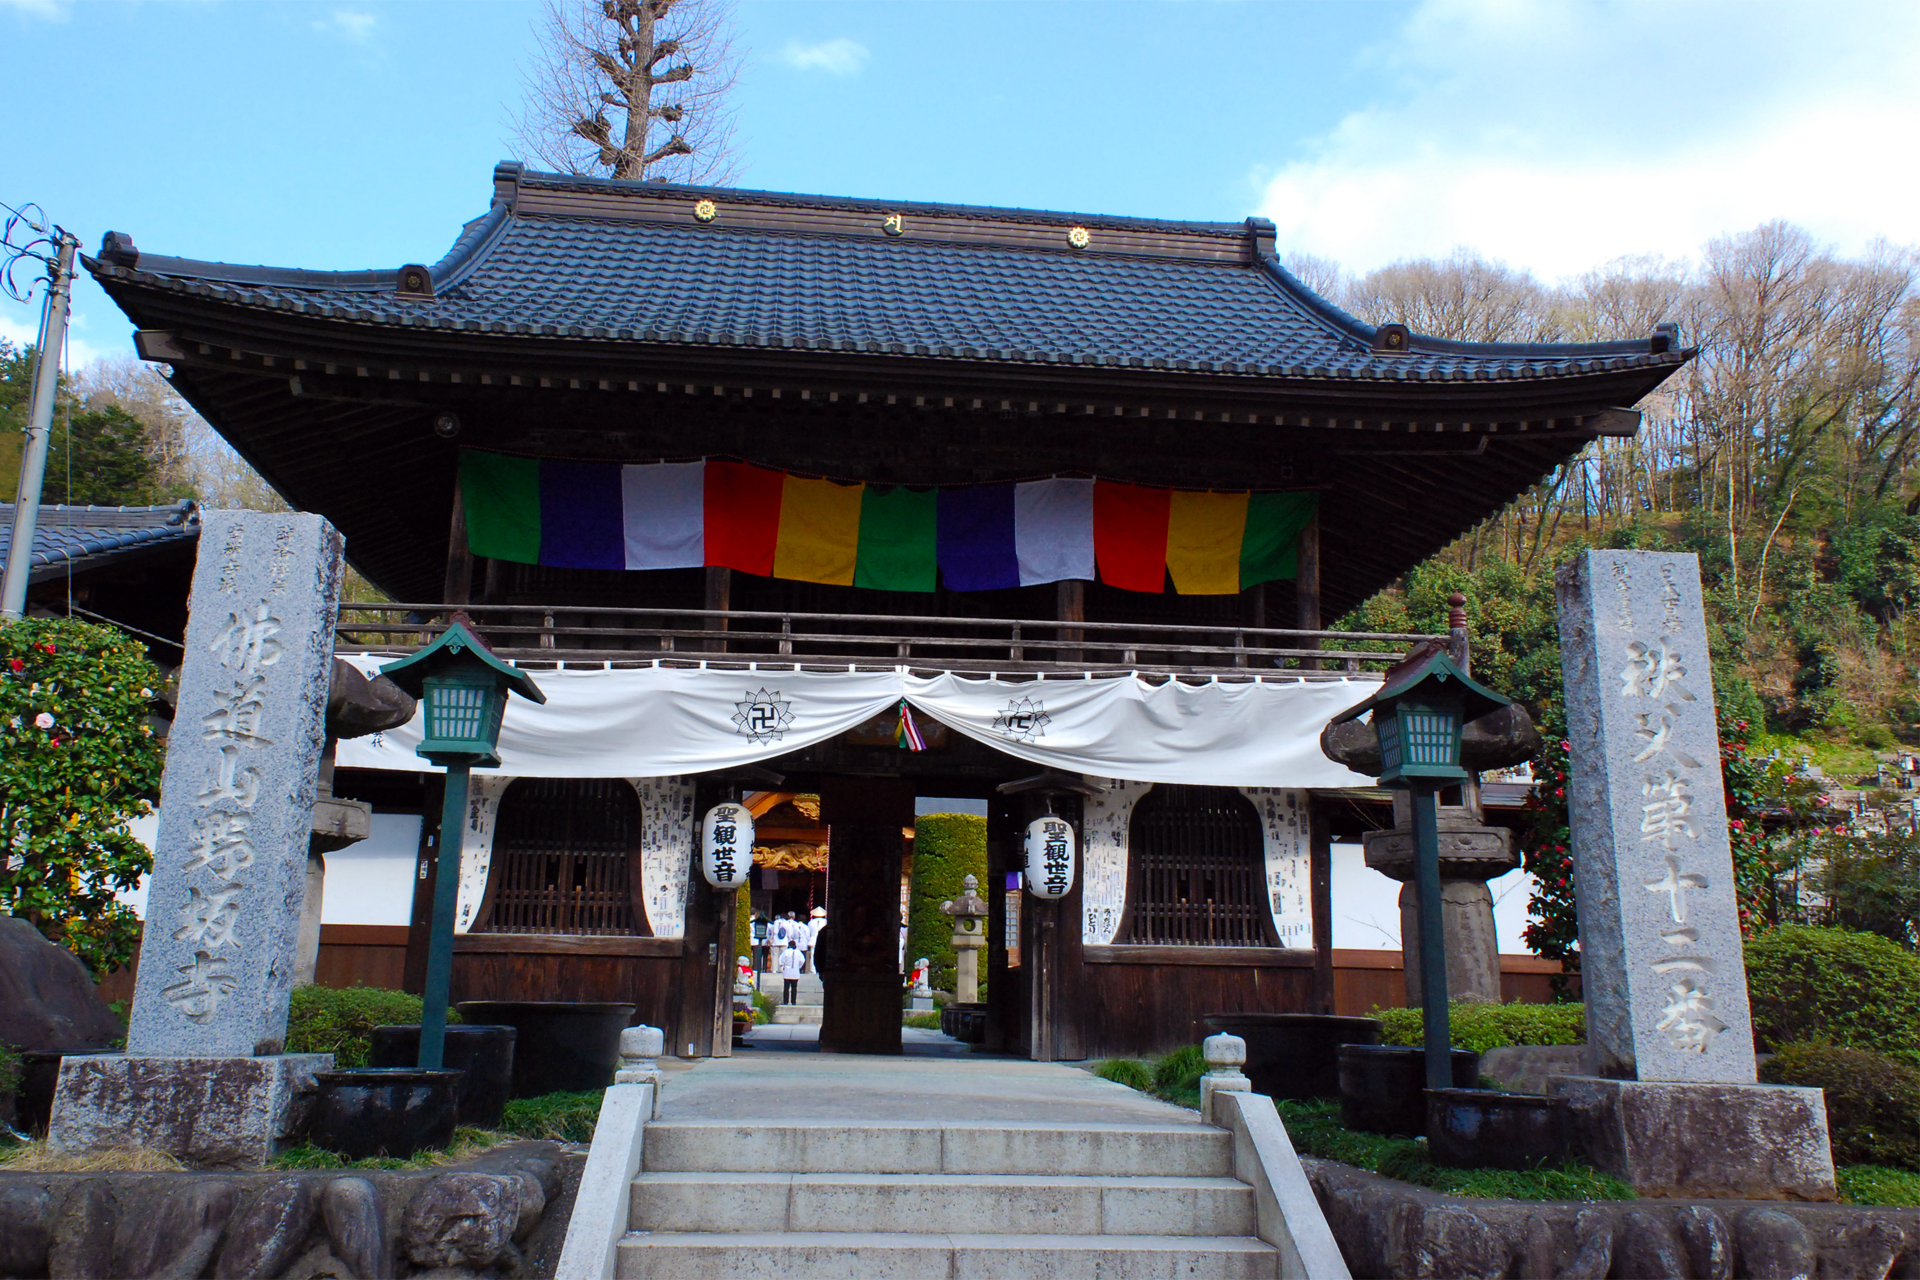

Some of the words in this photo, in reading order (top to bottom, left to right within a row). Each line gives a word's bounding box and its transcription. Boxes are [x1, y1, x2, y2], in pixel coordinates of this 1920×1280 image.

[712, 806, 740, 882] 聖観世音
[1043, 821, 1070, 895] 聖観世音
[1620, 635, 1731, 1053] 秩父第十二番
